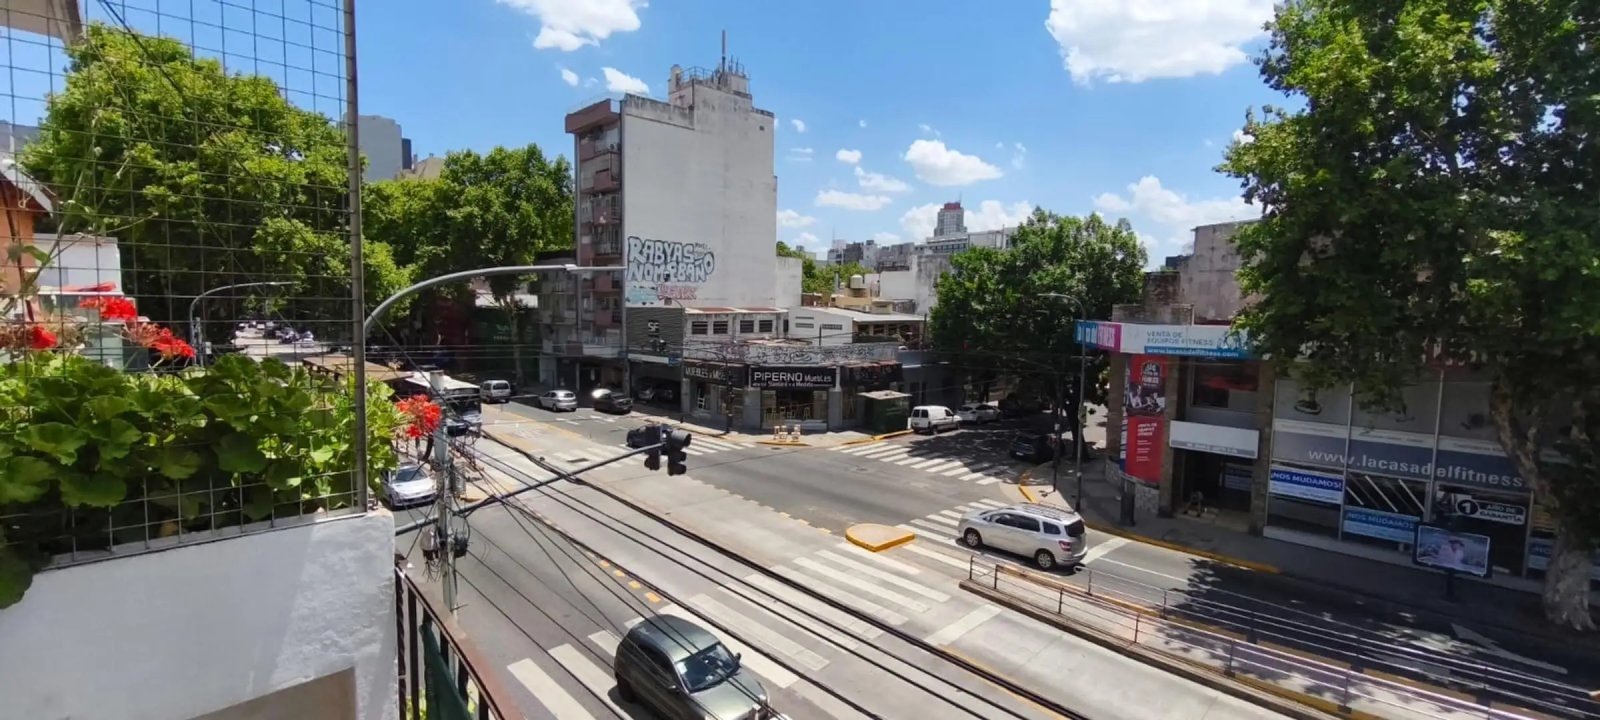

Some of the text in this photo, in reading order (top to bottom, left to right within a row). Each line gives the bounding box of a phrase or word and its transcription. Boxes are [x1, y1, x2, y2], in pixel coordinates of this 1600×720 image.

[754, 371, 802, 382] PIPERNO
[1292, 474, 1342, 489] MUDAMOS!
[1462, 502, 1471, 514] 1
